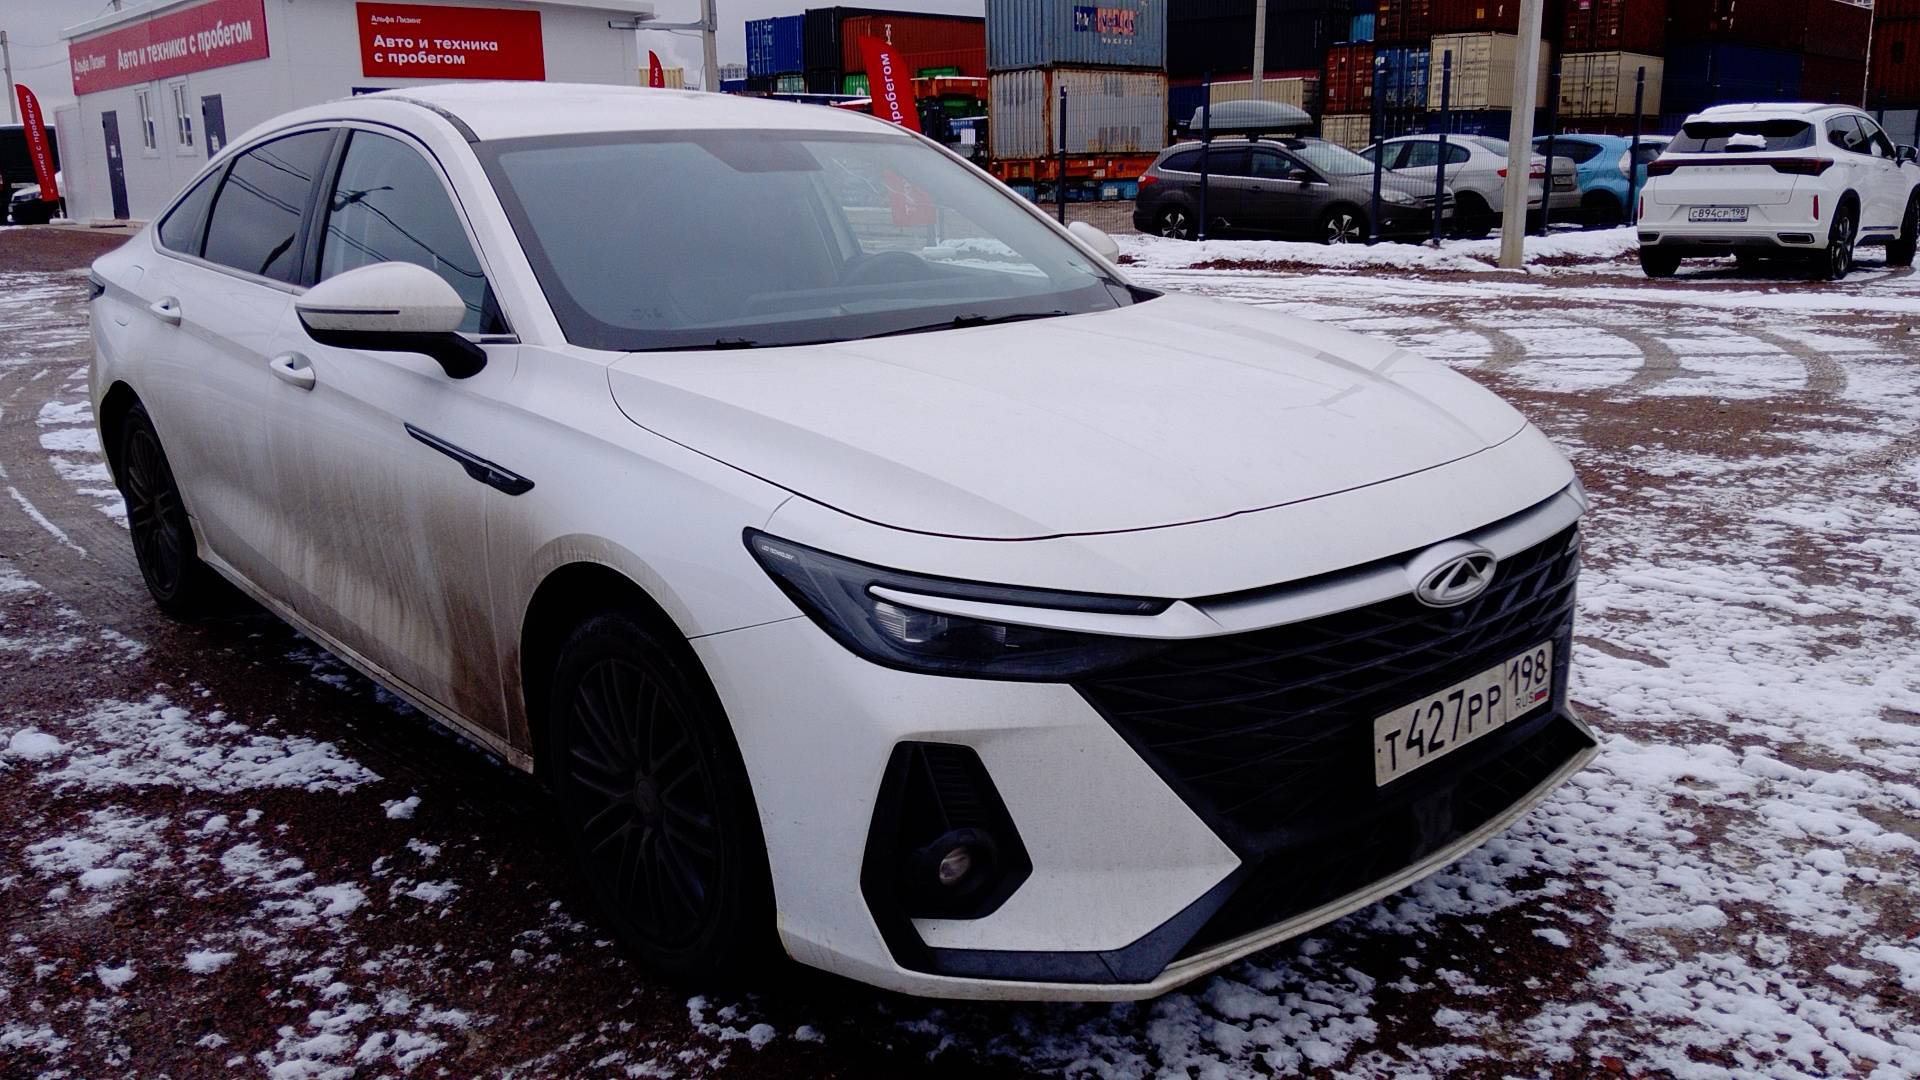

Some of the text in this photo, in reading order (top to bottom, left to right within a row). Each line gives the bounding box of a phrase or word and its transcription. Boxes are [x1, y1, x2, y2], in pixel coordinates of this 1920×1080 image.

[371, 15, 395, 24] Альфа
[117, 20, 252, 71] Авто и техника с пробегом
[374, 34, 498, 51] Авто и техника
[374, 51, 466, 65] с пробегом
[25, 95, 40, 143] пробегом
[1384, 649, 1548, 771] Т427РР 198
[1515, 691, 1535, 711] RUS
